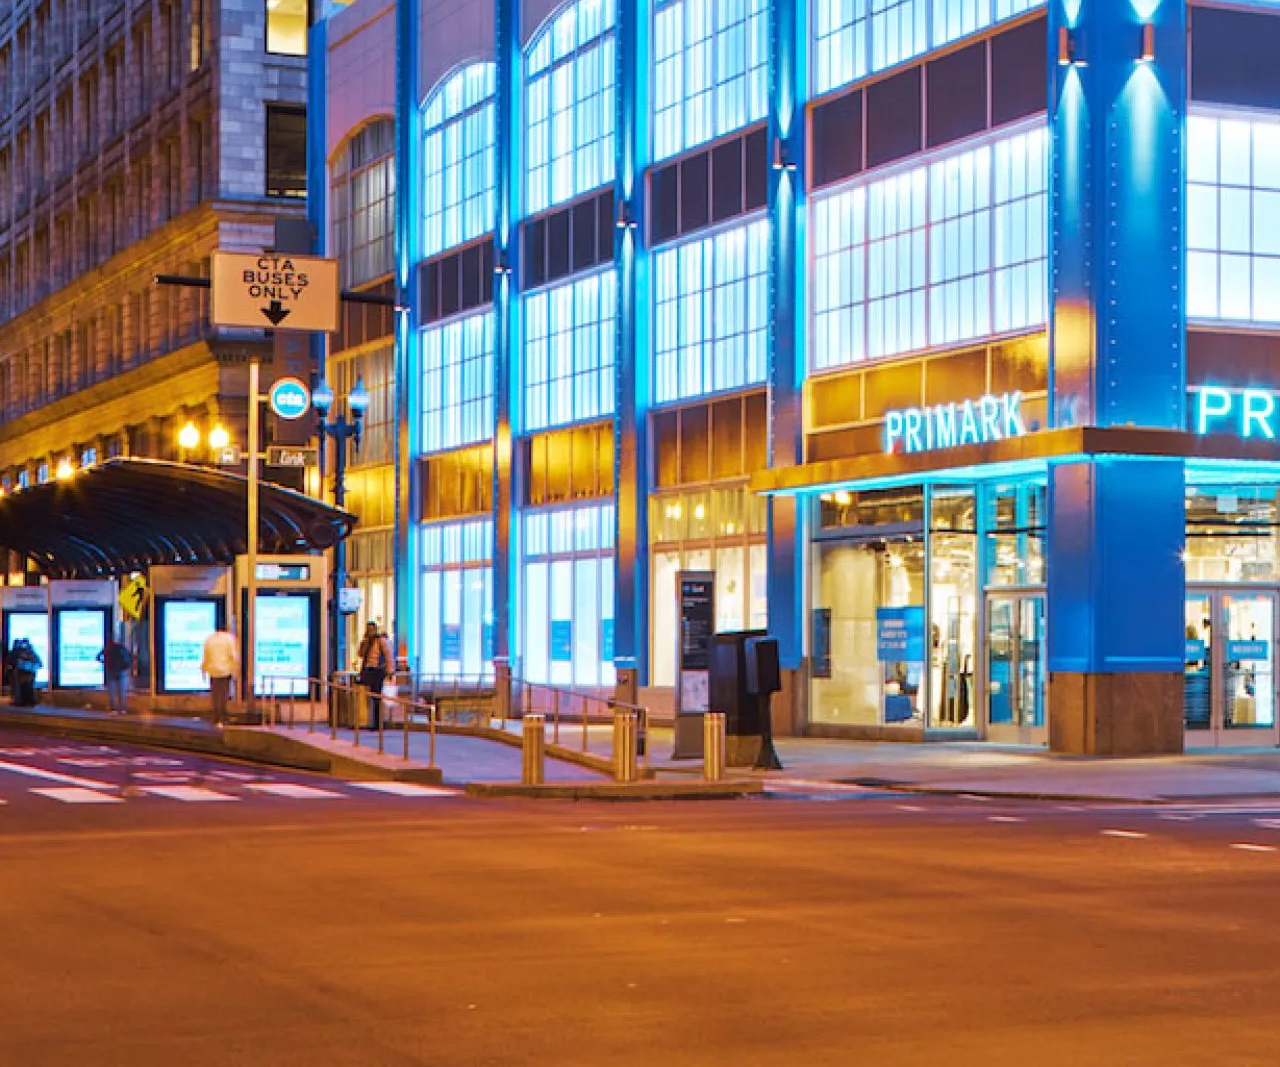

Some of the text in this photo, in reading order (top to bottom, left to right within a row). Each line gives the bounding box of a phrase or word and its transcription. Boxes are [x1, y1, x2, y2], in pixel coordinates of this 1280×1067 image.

[257, 257, 294, 271] CTA
[243, 270, 309, 286] BUSES
[249, 285, 303, 300] ONLY
[884, 390, 1026, 454] PRIMARK
